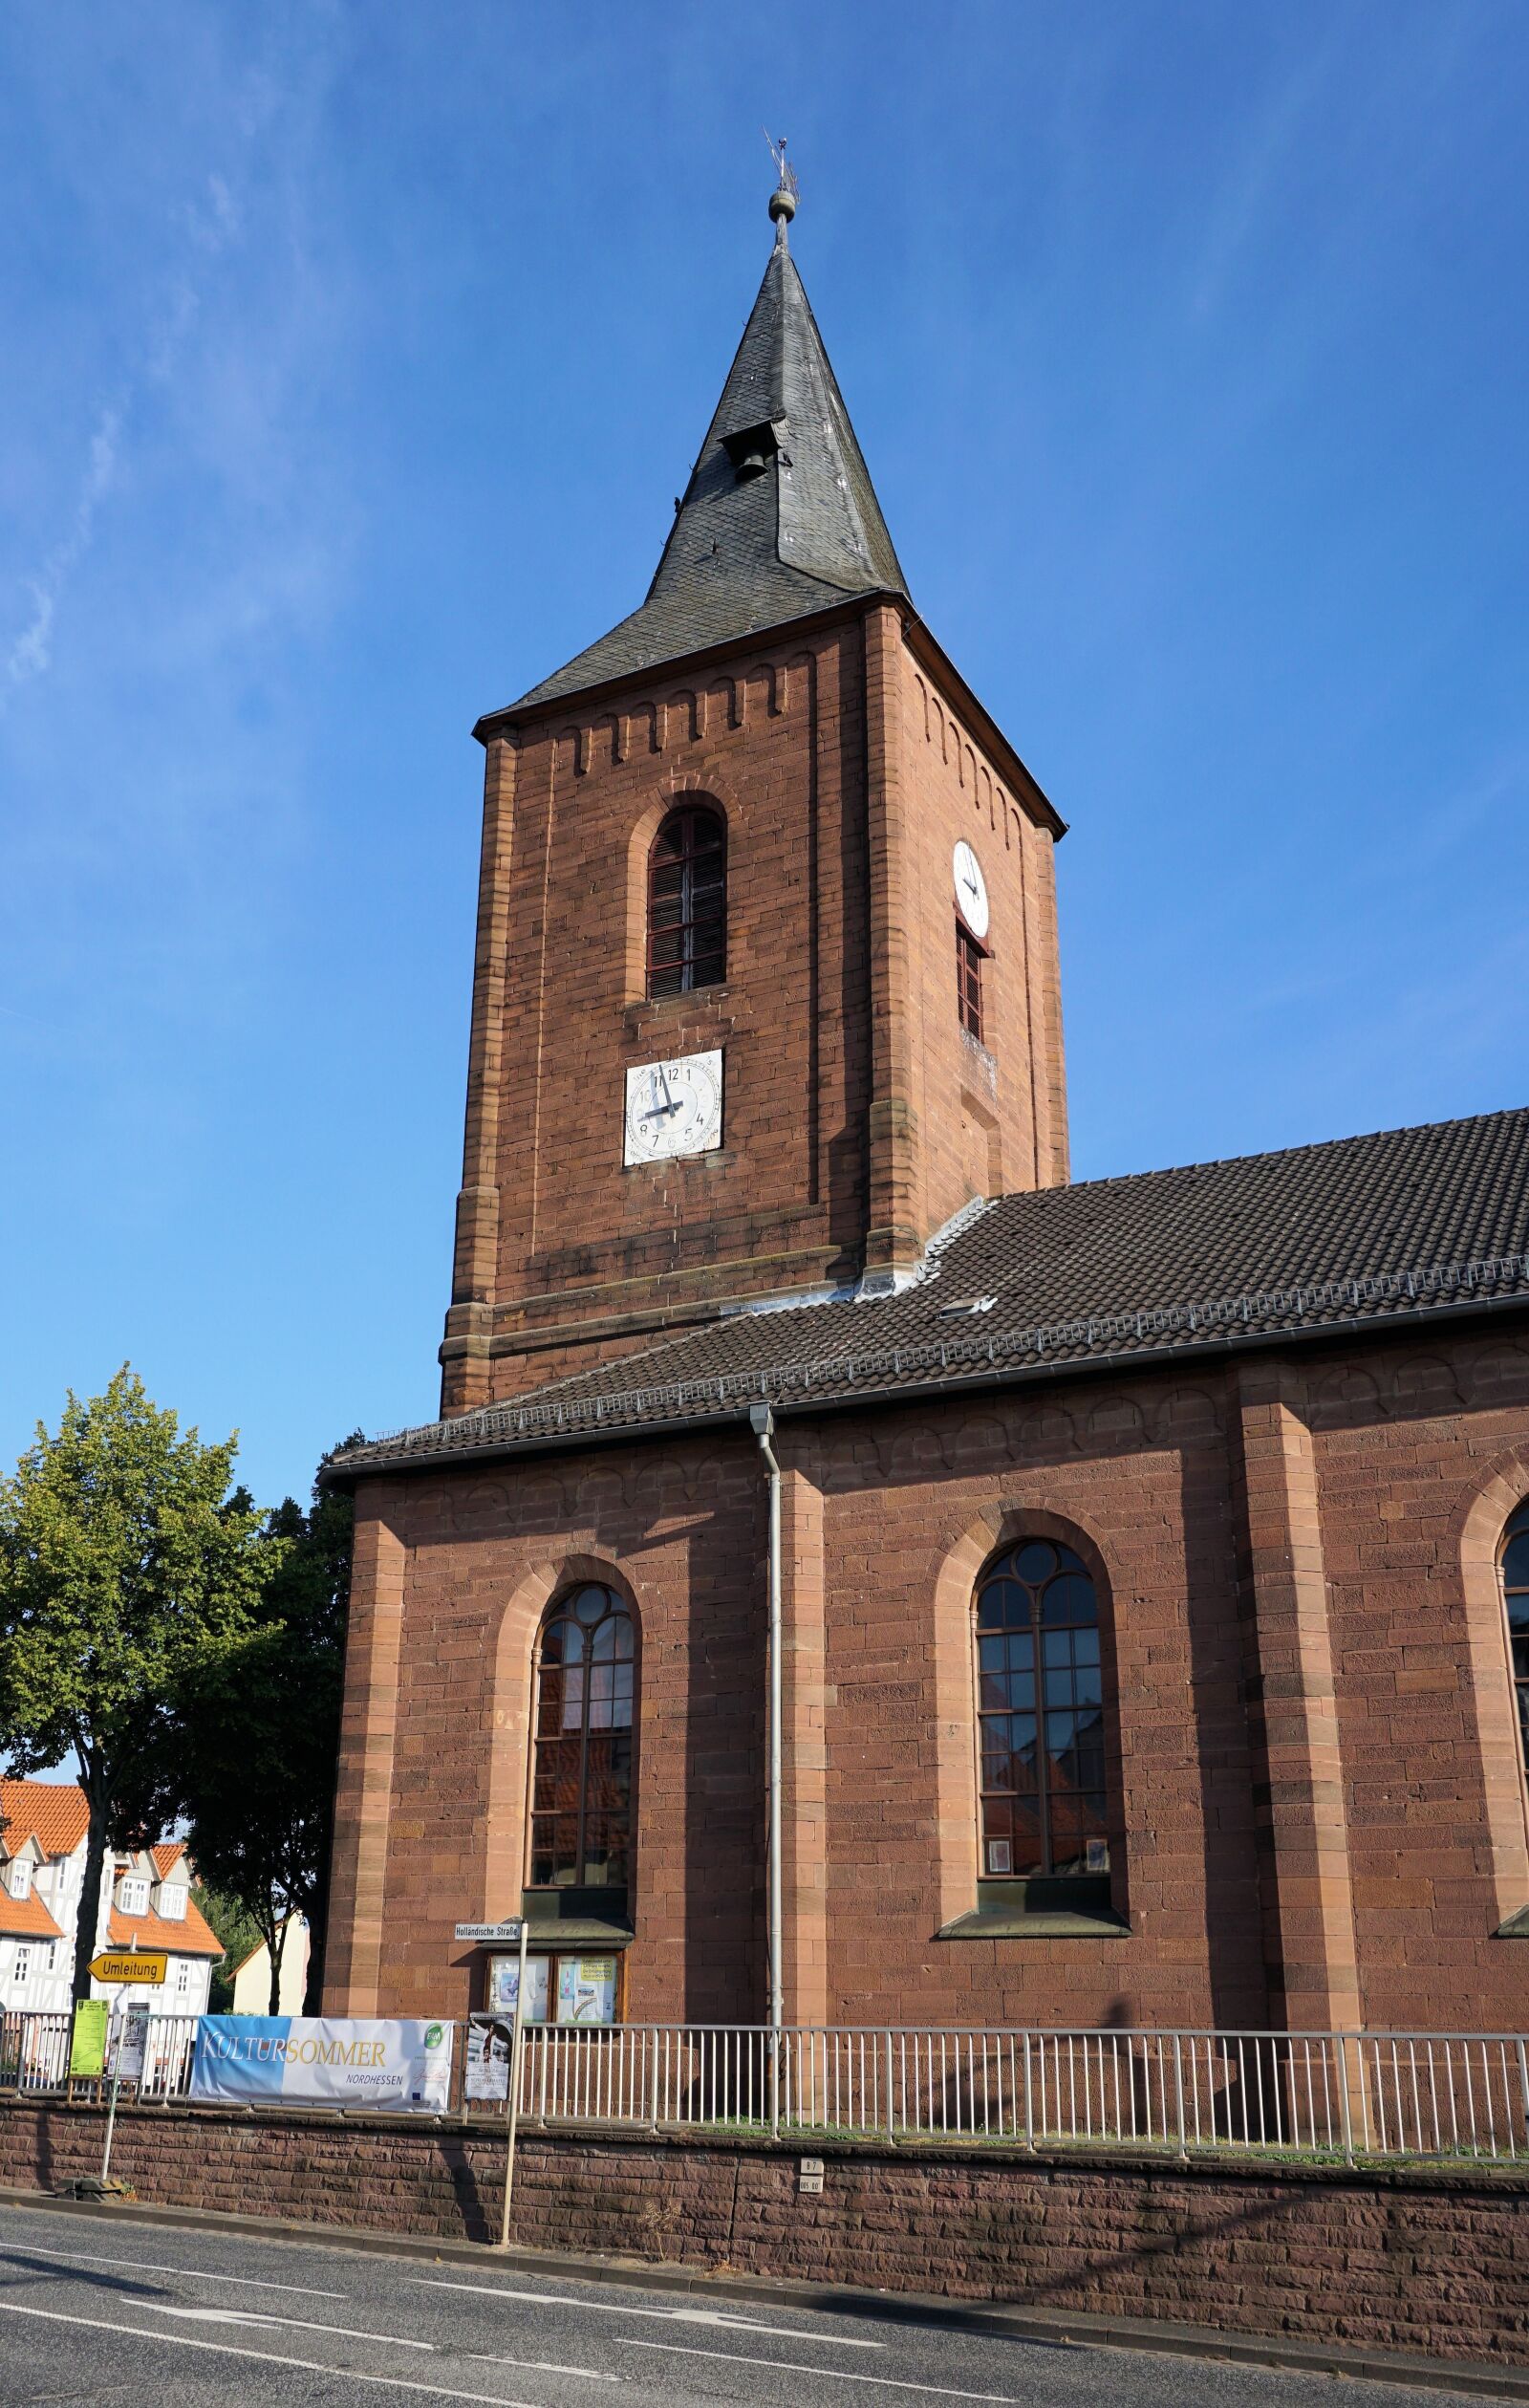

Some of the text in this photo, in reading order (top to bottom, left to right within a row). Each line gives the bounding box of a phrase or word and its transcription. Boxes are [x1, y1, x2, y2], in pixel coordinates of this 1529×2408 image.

[668, 1068, 678, 1081] 12
[686, 1068, 691, 1082] 1
[654, 1075, 663, 1088] 11
[696, 1113, 704, 1126] 4
[639, 1123, 648, 1138] 8
[684, 1128, 693, 1142] 5
[652, 1135, 659, 1148] 7
[456, 1926, 517, 1936] Holländische Straße
[103, 1961, 158, 1980] Umleitung
[346, 2073, 403, 2086] NORDHESSEN
